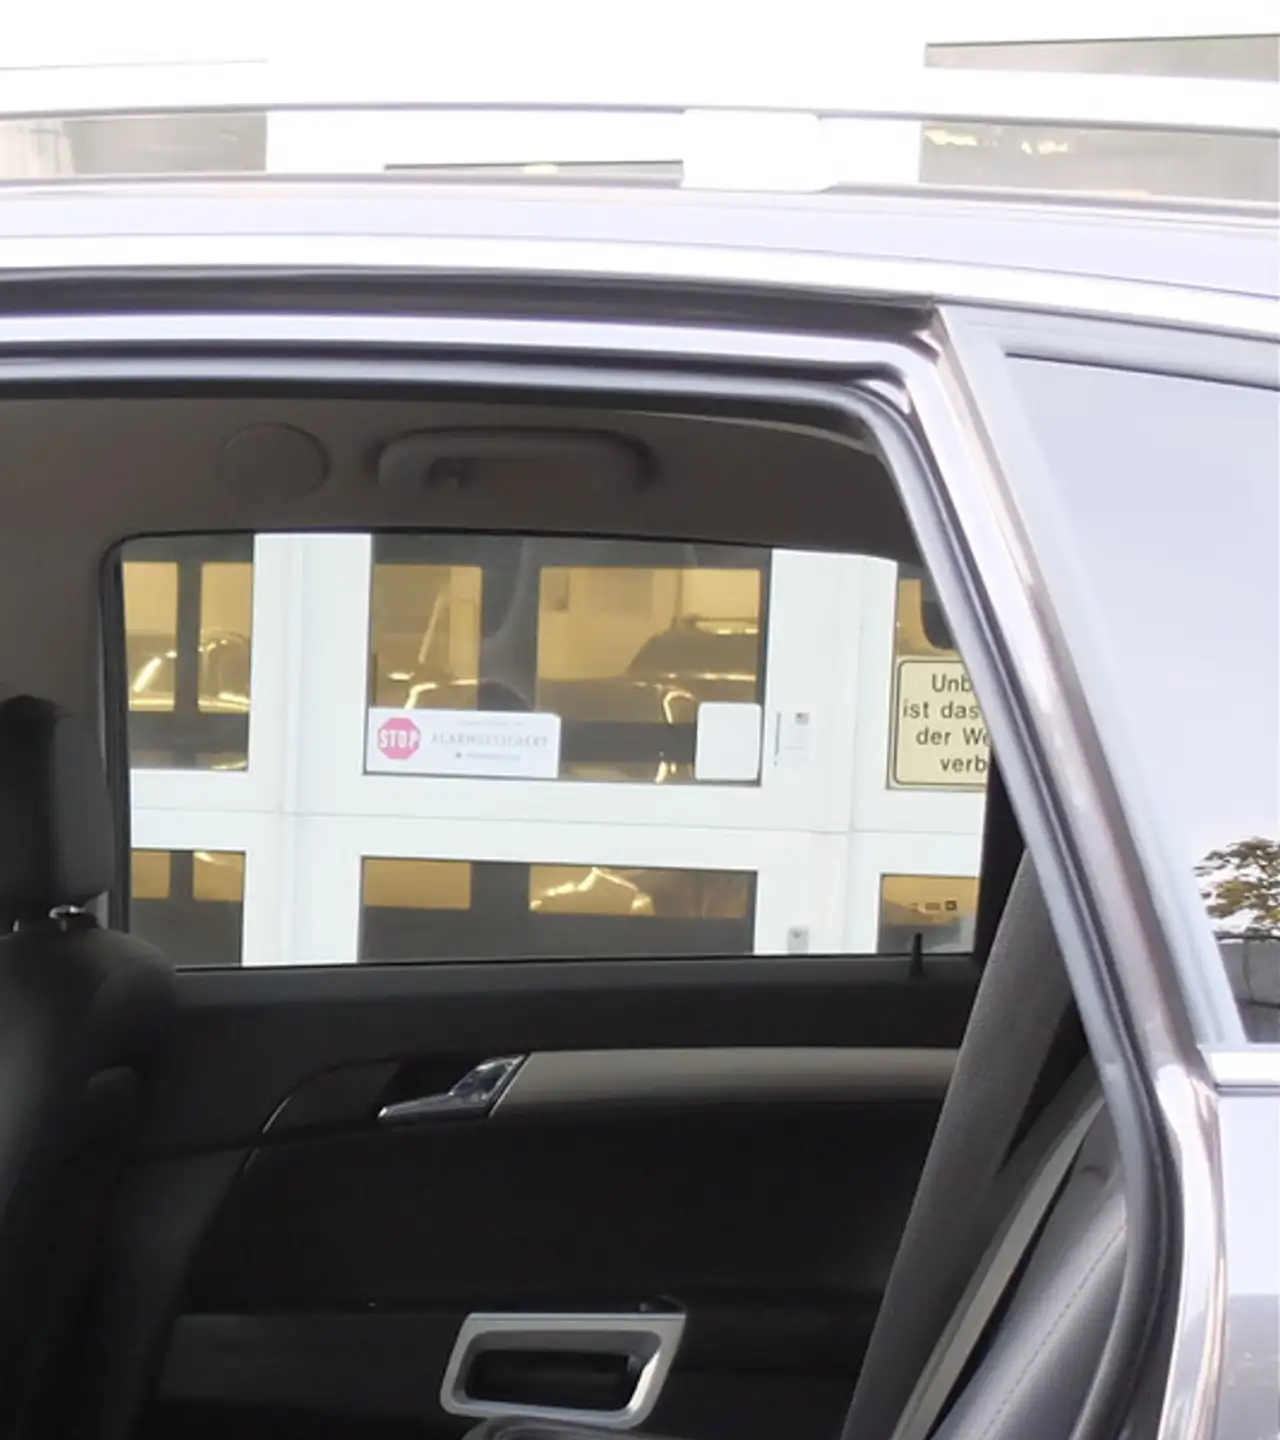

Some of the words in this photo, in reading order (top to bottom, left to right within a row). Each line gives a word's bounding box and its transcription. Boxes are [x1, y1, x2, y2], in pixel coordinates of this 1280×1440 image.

[902, 698, 930, 719] ist
[940, 700, 980, 719] das
[378, 729, 420, 750] STOP
[915, 726, 952, 746] der
[939, 754, 987, 773] verb
